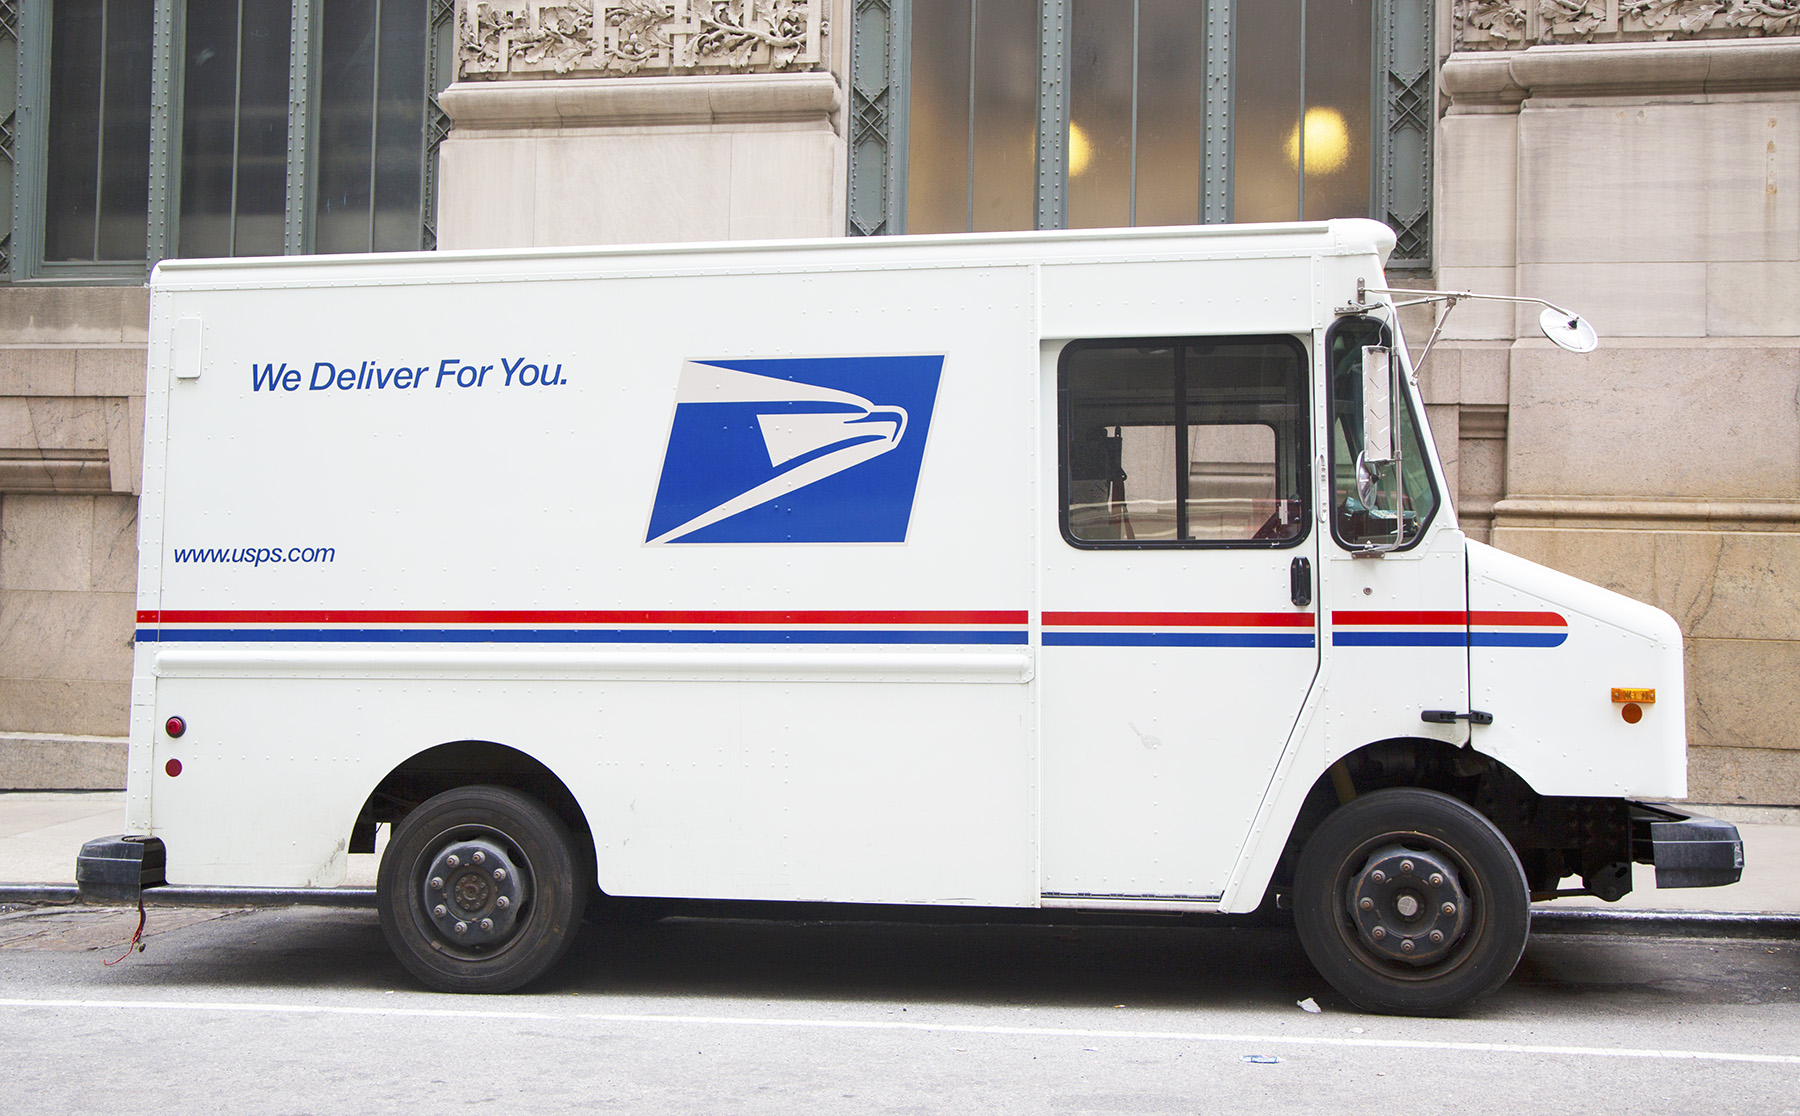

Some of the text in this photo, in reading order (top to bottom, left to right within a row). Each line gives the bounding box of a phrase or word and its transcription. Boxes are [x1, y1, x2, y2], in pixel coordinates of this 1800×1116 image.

[252, 356, 568, 392] We Deliver For You.
[174, 547, 336, 568] www.usps.com
